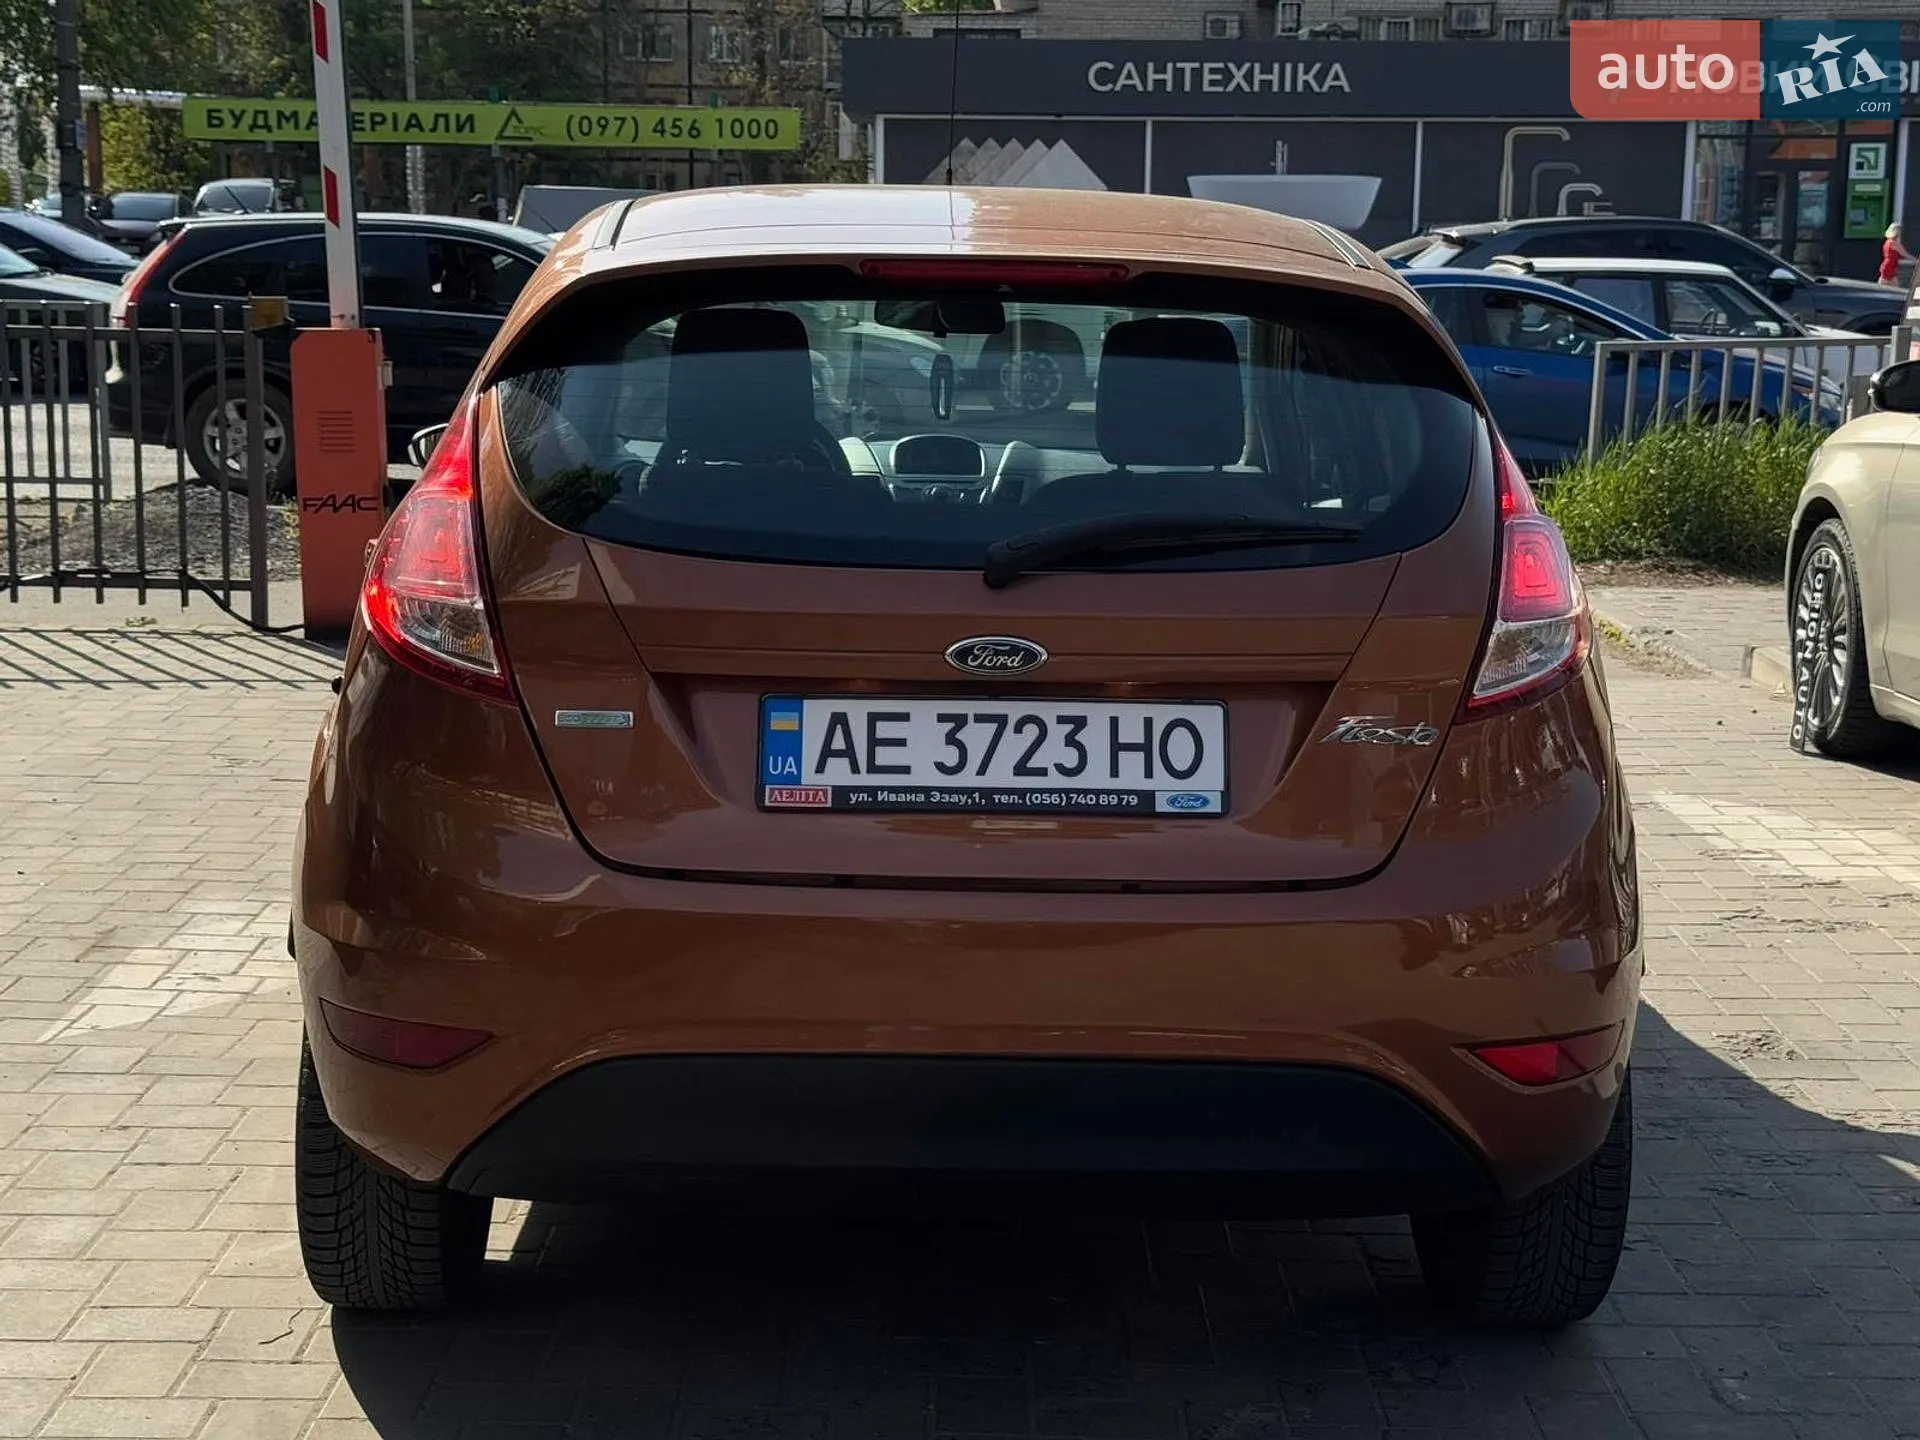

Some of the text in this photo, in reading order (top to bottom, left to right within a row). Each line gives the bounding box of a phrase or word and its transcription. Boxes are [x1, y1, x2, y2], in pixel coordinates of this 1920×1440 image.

[1087, 61, 1351, 93] САНТЕХНІКА
[206, 108, 475, 133] БУДМАЕРІАЛИ
[566, 114, 639, 142] (097)
[652, 117, 702, 139] 456
[715, 117, 779, 140] 1000
[302, 493, 379, 514] FAAC
[1792, 665, 1810, 740] AUTO
[814, 711, 1205, 781] AE 3723 HO
[768, 756, 798, 776] UA
[849, 791, 873, 804] ул.
[877, 791, 925, 802] Ивана
